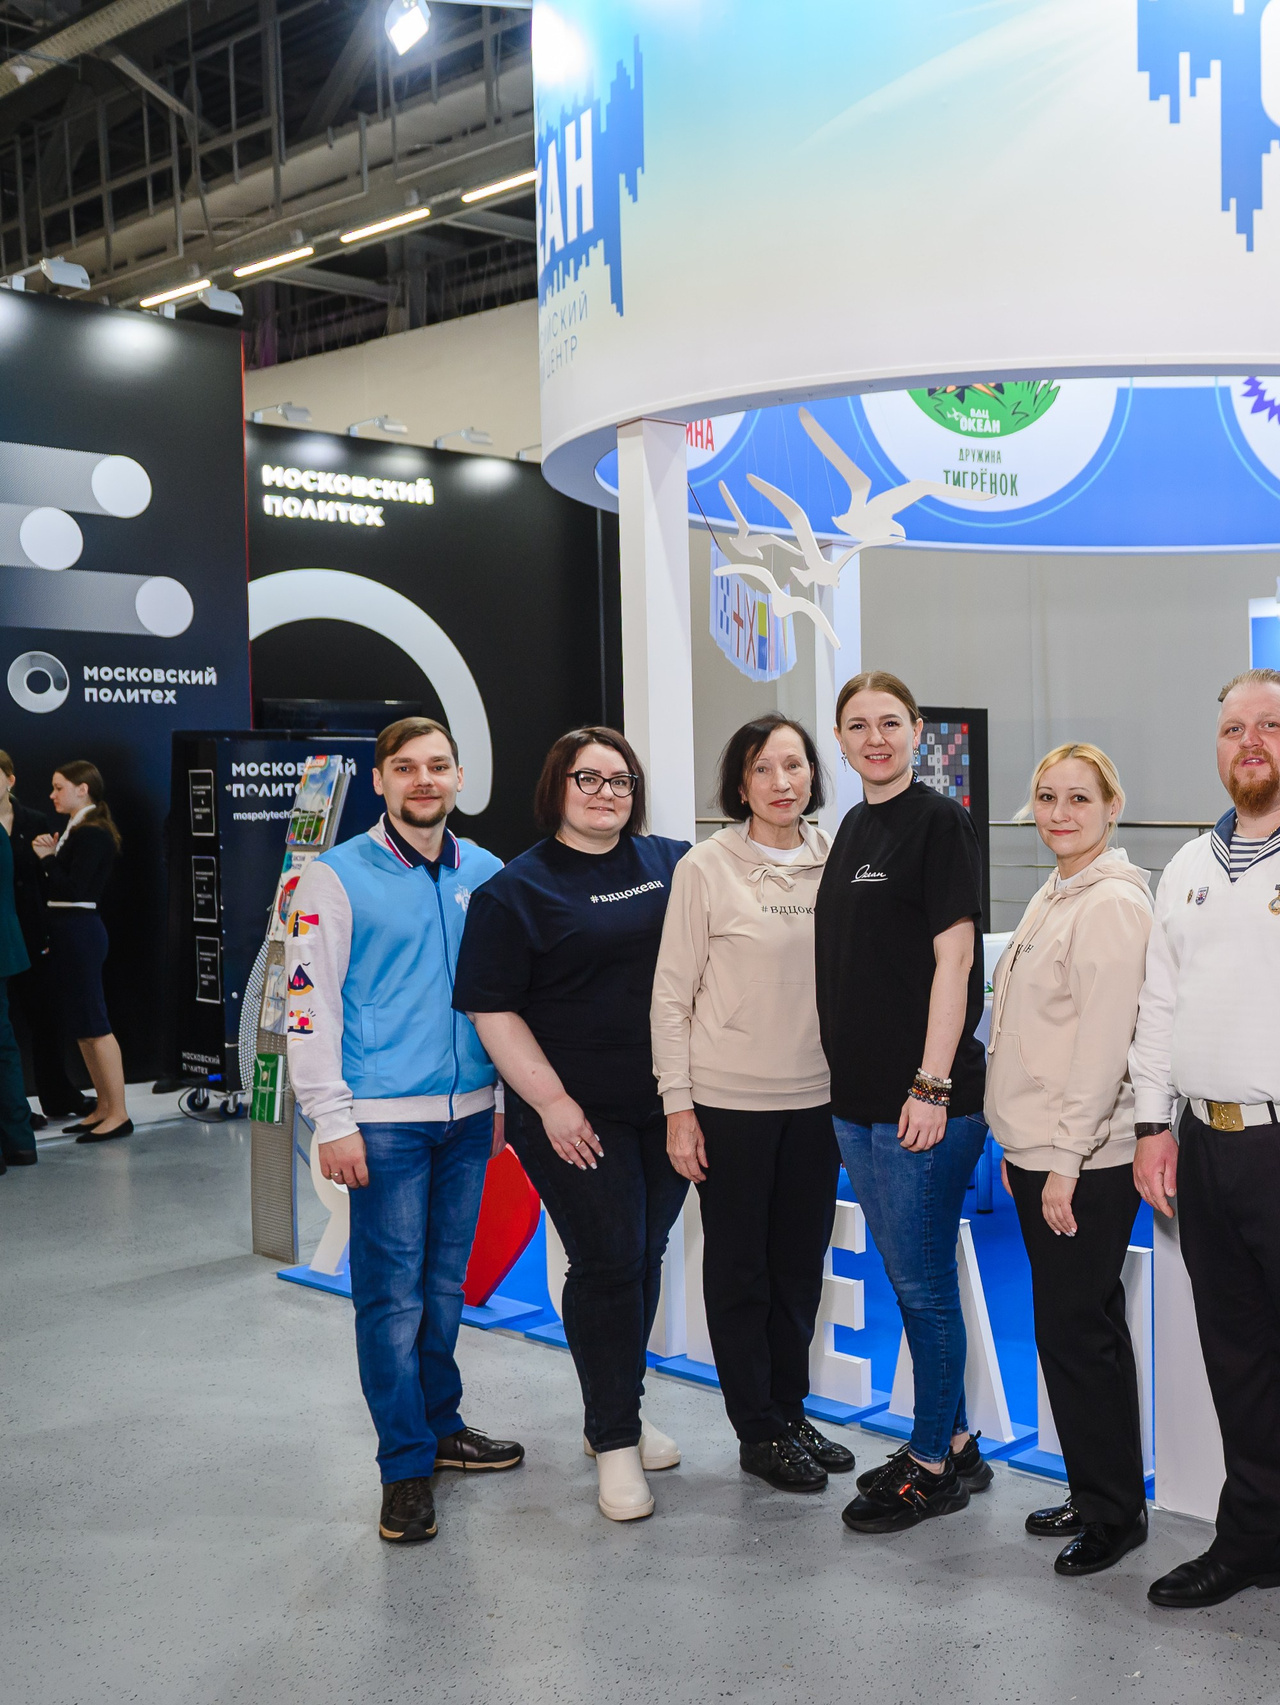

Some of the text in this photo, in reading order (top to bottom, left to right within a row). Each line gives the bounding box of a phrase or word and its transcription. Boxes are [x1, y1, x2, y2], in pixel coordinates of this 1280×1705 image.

[959, 418, 1001, 434] ОКЕАН
[958, 448, 1002, 464] ДРУЖИНА
[943, 468, 1018, 497] ТИГРЁНОК
[590, 880, 665, 904] #вдцокеан
